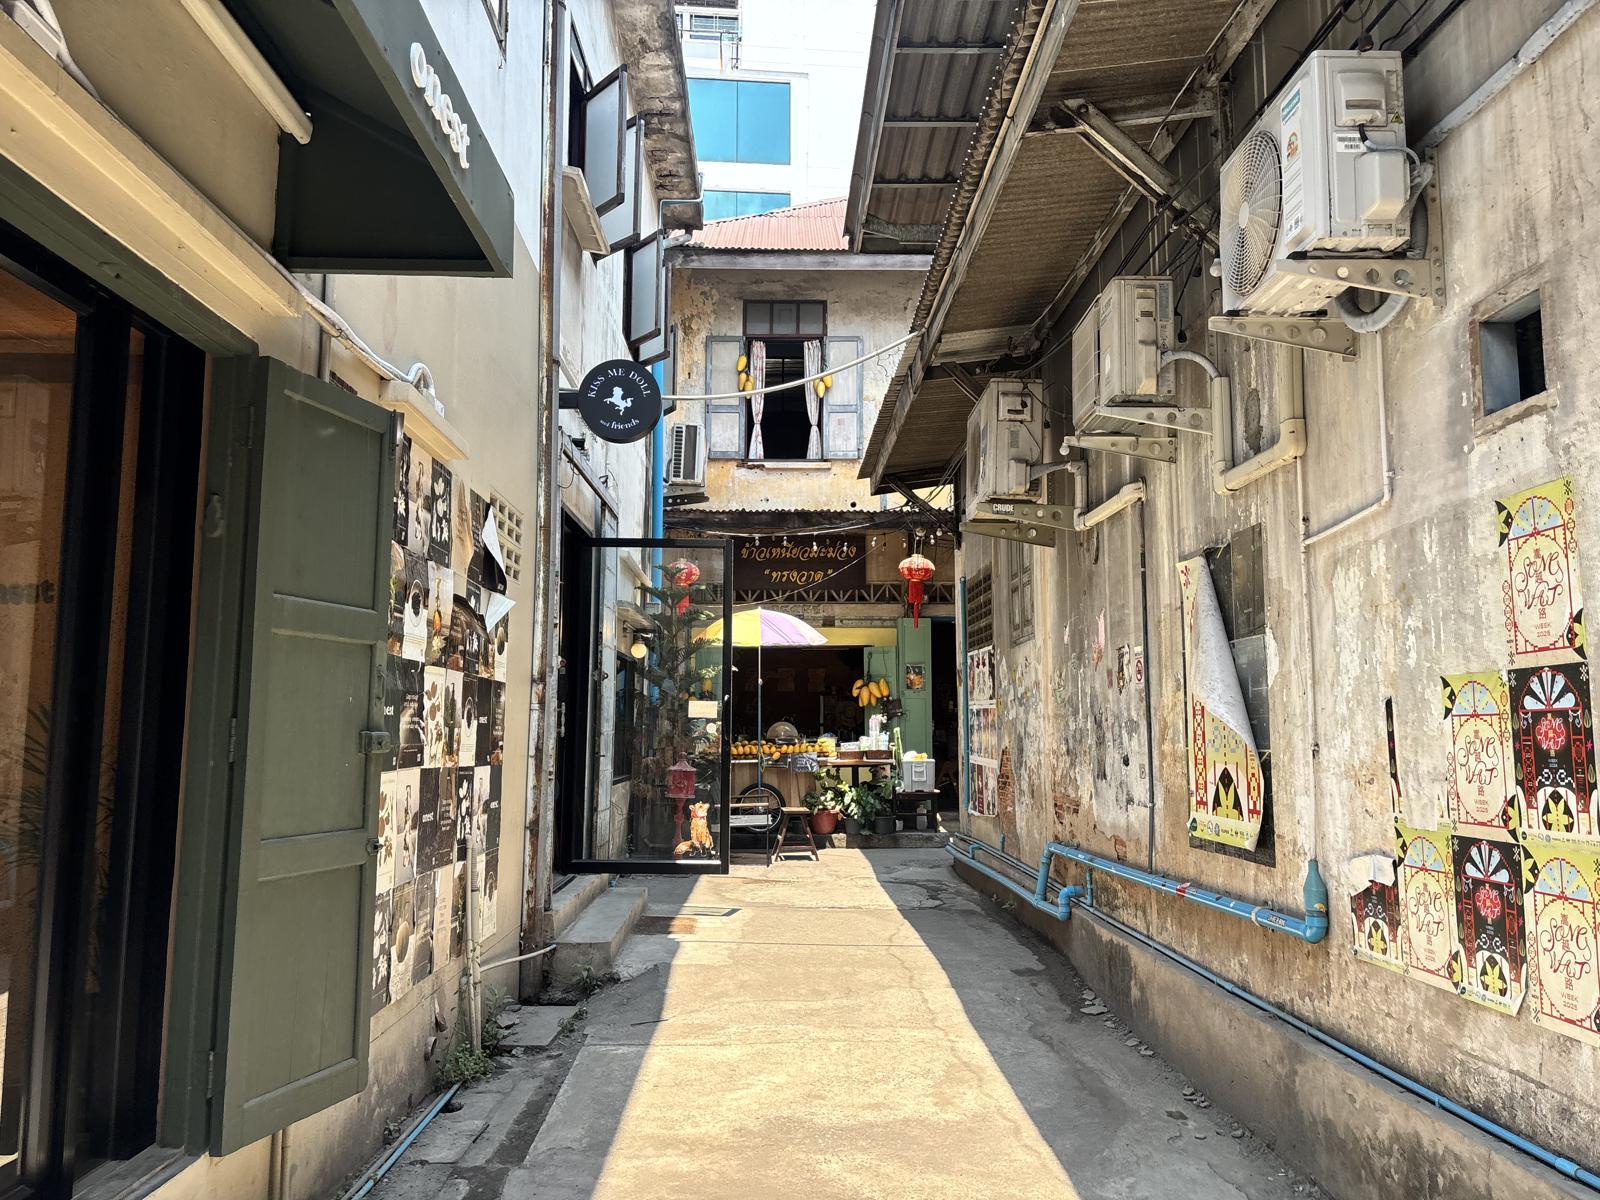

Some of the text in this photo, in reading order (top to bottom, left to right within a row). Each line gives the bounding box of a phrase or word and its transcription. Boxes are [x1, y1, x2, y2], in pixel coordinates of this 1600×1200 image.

[588, 367, 652, 398] KISS ME DOLL
[610, 418, 640, 430] friends
[992, 503, 1015, 512] CRUDE
[1515, 551, 1564, 592] SONG
[1457, 735, 1499, 766] SONG
[1540, 917, 1591, 961] SONG
